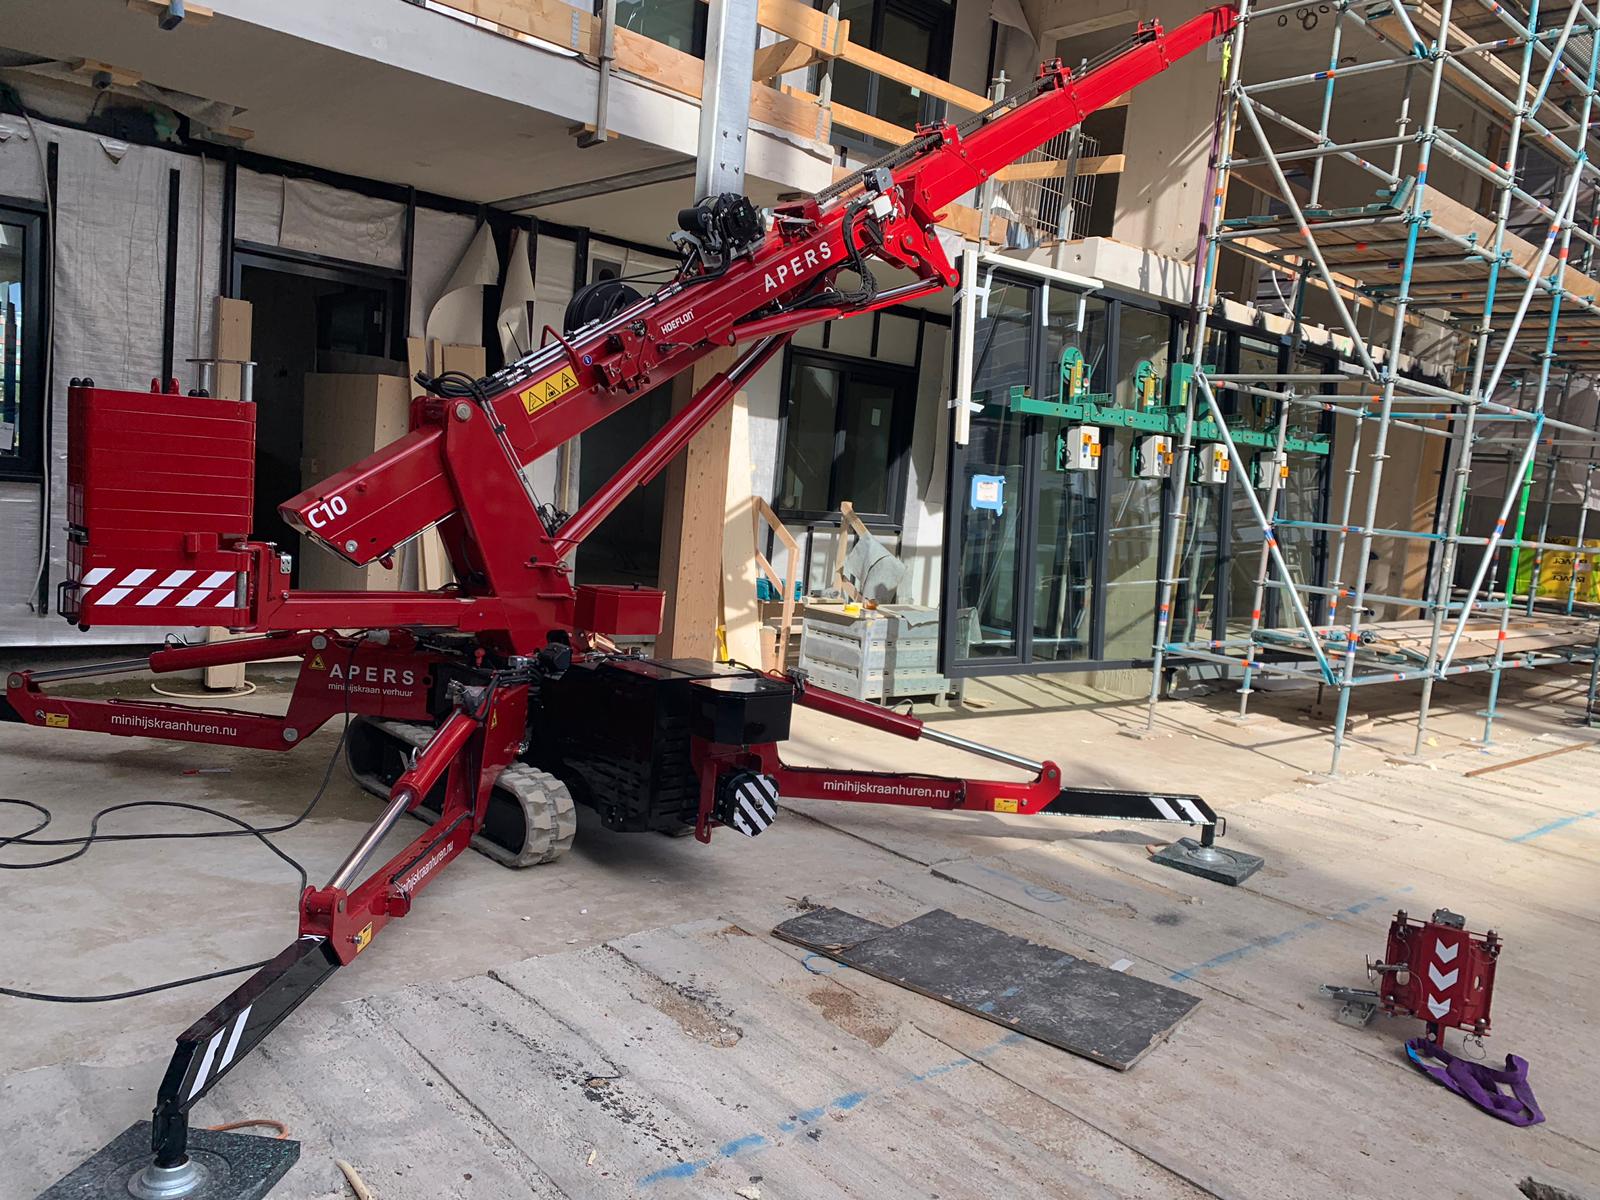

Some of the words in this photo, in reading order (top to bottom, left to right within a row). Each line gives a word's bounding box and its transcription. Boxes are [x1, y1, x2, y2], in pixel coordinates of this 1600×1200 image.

[764, 241, 832, 293] APERS
[660, 310, 695, 335] HOEFLON
[307, 495, 348, 528] C10
[329, 663, 414, 685] APERS
[382, 687, 413, 697] verhuur
[111, 714, 237, 736] minihijskraanhuren.nu
[823, 780, 950, 799] minihijskraanhuren.nu
